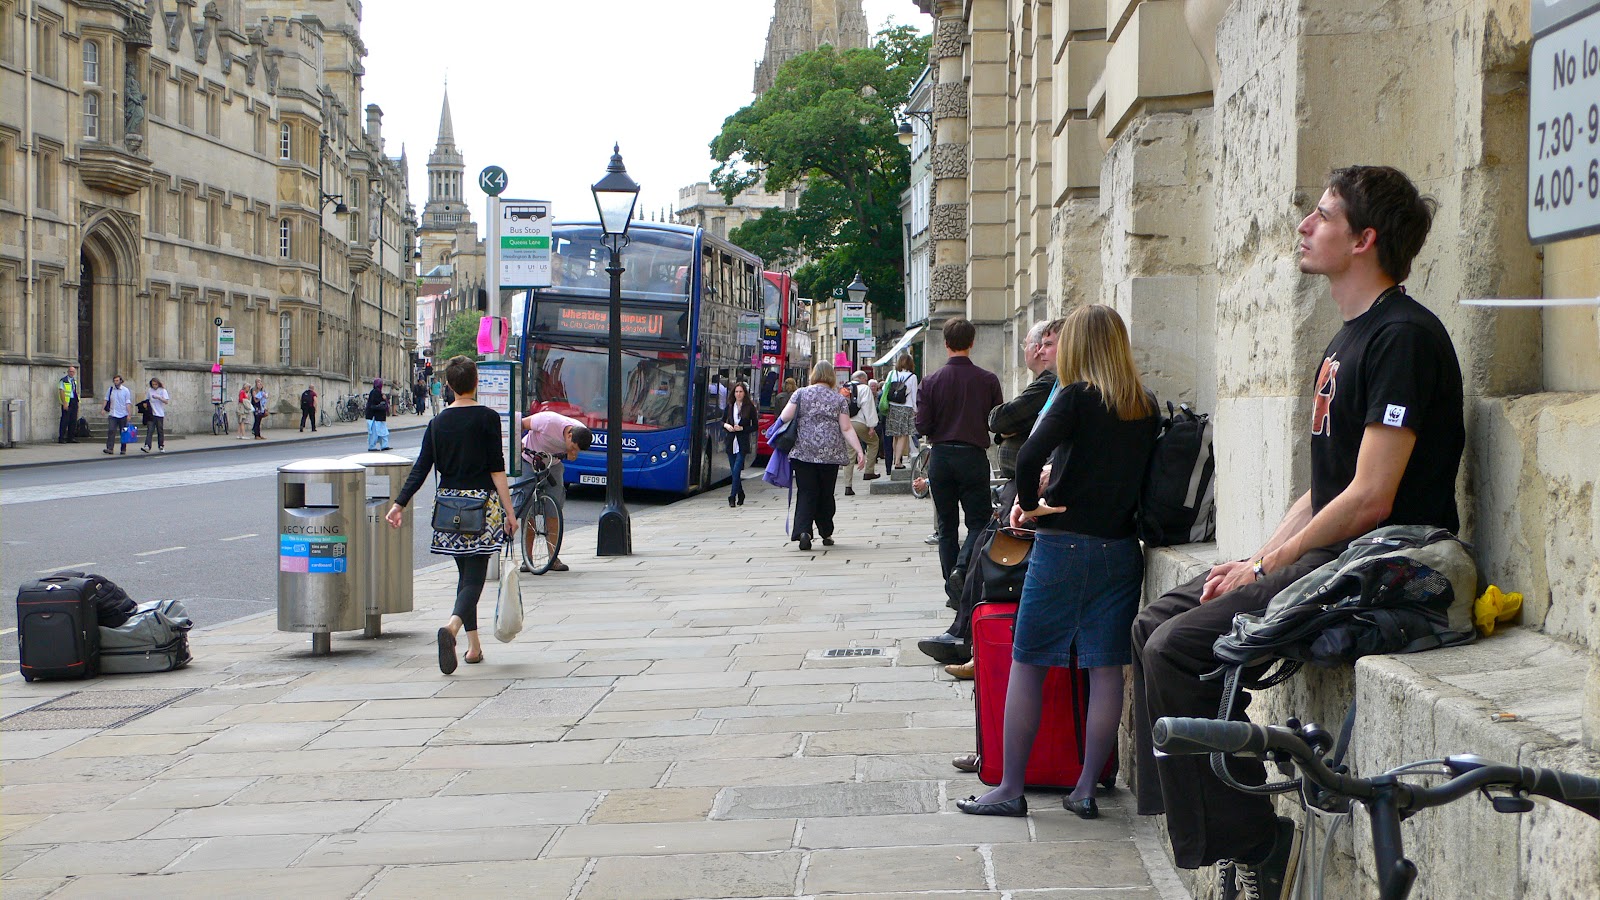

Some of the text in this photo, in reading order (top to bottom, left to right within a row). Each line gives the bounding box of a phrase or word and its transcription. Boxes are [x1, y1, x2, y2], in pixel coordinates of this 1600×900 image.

[1553, 39, 1600, 90] No lo
[481, 171, 505, 188] K4
[510, 226, 541, 235] Bus Stop
[832, 287, 844, 296] K3
[562, 308, 647, 324] Wheatley mpus
[570, 321, 583, 329] City
[765, 328, 778, 337] Tour
[583, 476, 600, 484] EF09
[283, 525, 339, 534] RECYCLING
